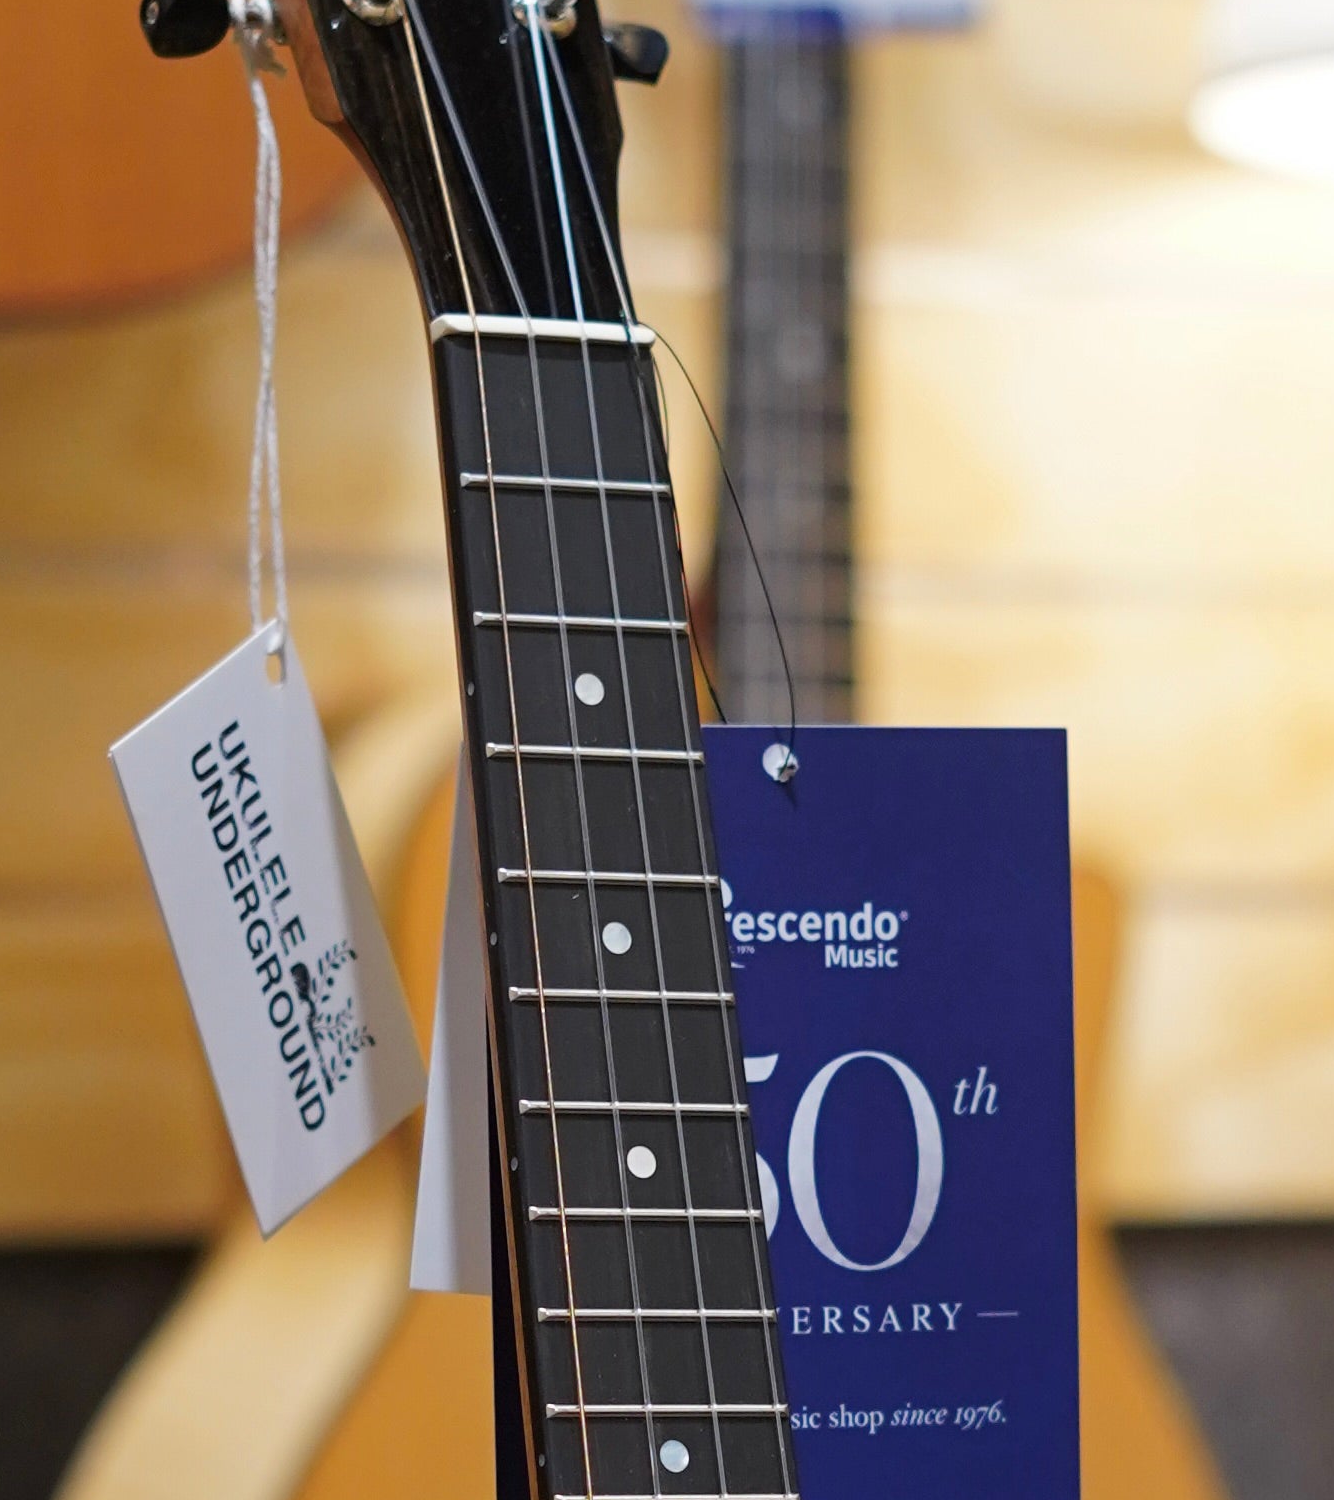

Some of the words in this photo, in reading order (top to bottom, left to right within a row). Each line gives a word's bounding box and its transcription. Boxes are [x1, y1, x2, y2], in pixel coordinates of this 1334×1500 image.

[219, 720, 307, 957] UKULELE
[191, 741, 327, 1131] UNDERGROUND
[825, 943, 899, 968] Music
[790, 1405, 822, 1429] sic
[828, 1403, 884, 1435] shop
[890, 1402, 947, 1427] since
[953, 1400, 1007, 1431] 1976.
